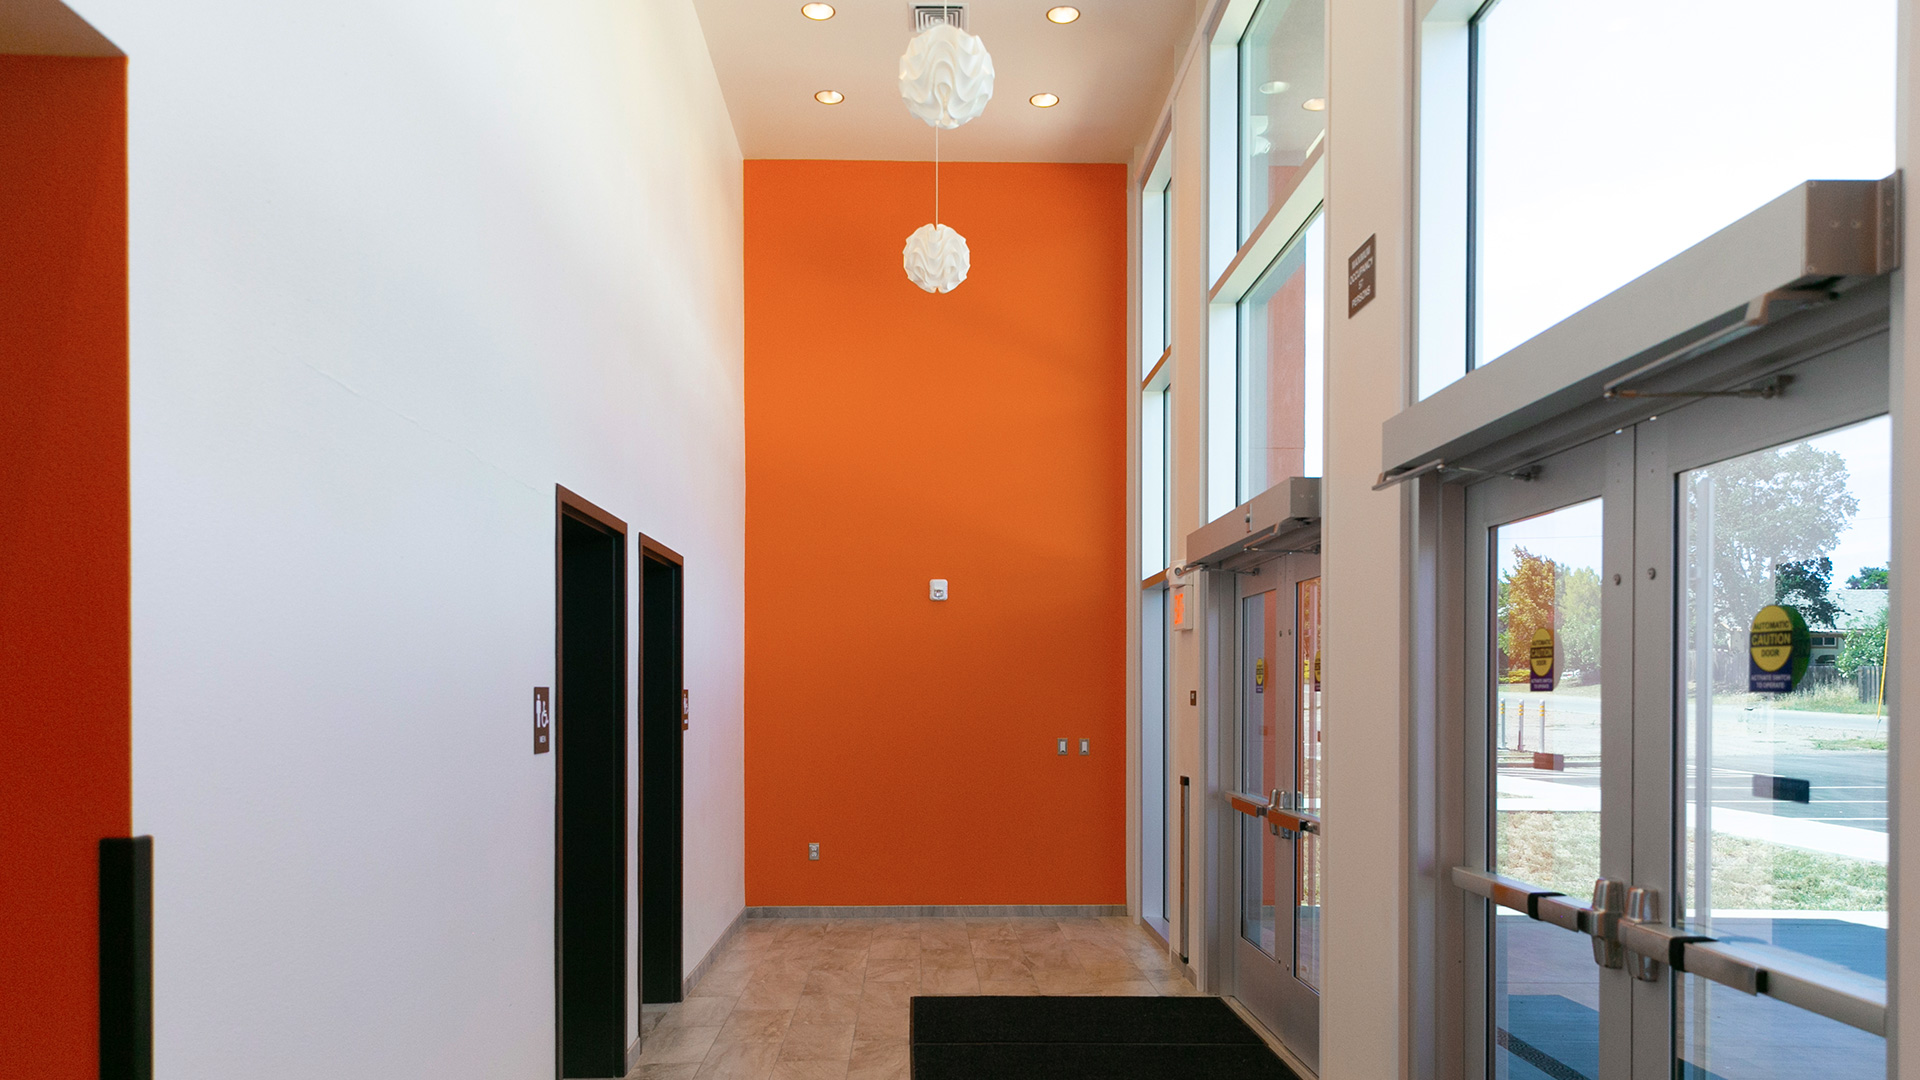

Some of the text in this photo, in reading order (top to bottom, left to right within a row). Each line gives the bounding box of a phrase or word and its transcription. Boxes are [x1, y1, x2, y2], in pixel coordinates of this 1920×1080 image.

[1349, 256, 1374, 285] OCCUPANCY
[1351, 284, 1371, 309] PERSONS
[1753, 620, 1790, 630] AUTOMATIC
[1751, 633, 1791, 646] CAUTION
[1761, 649, 1780, 658] DOOR
